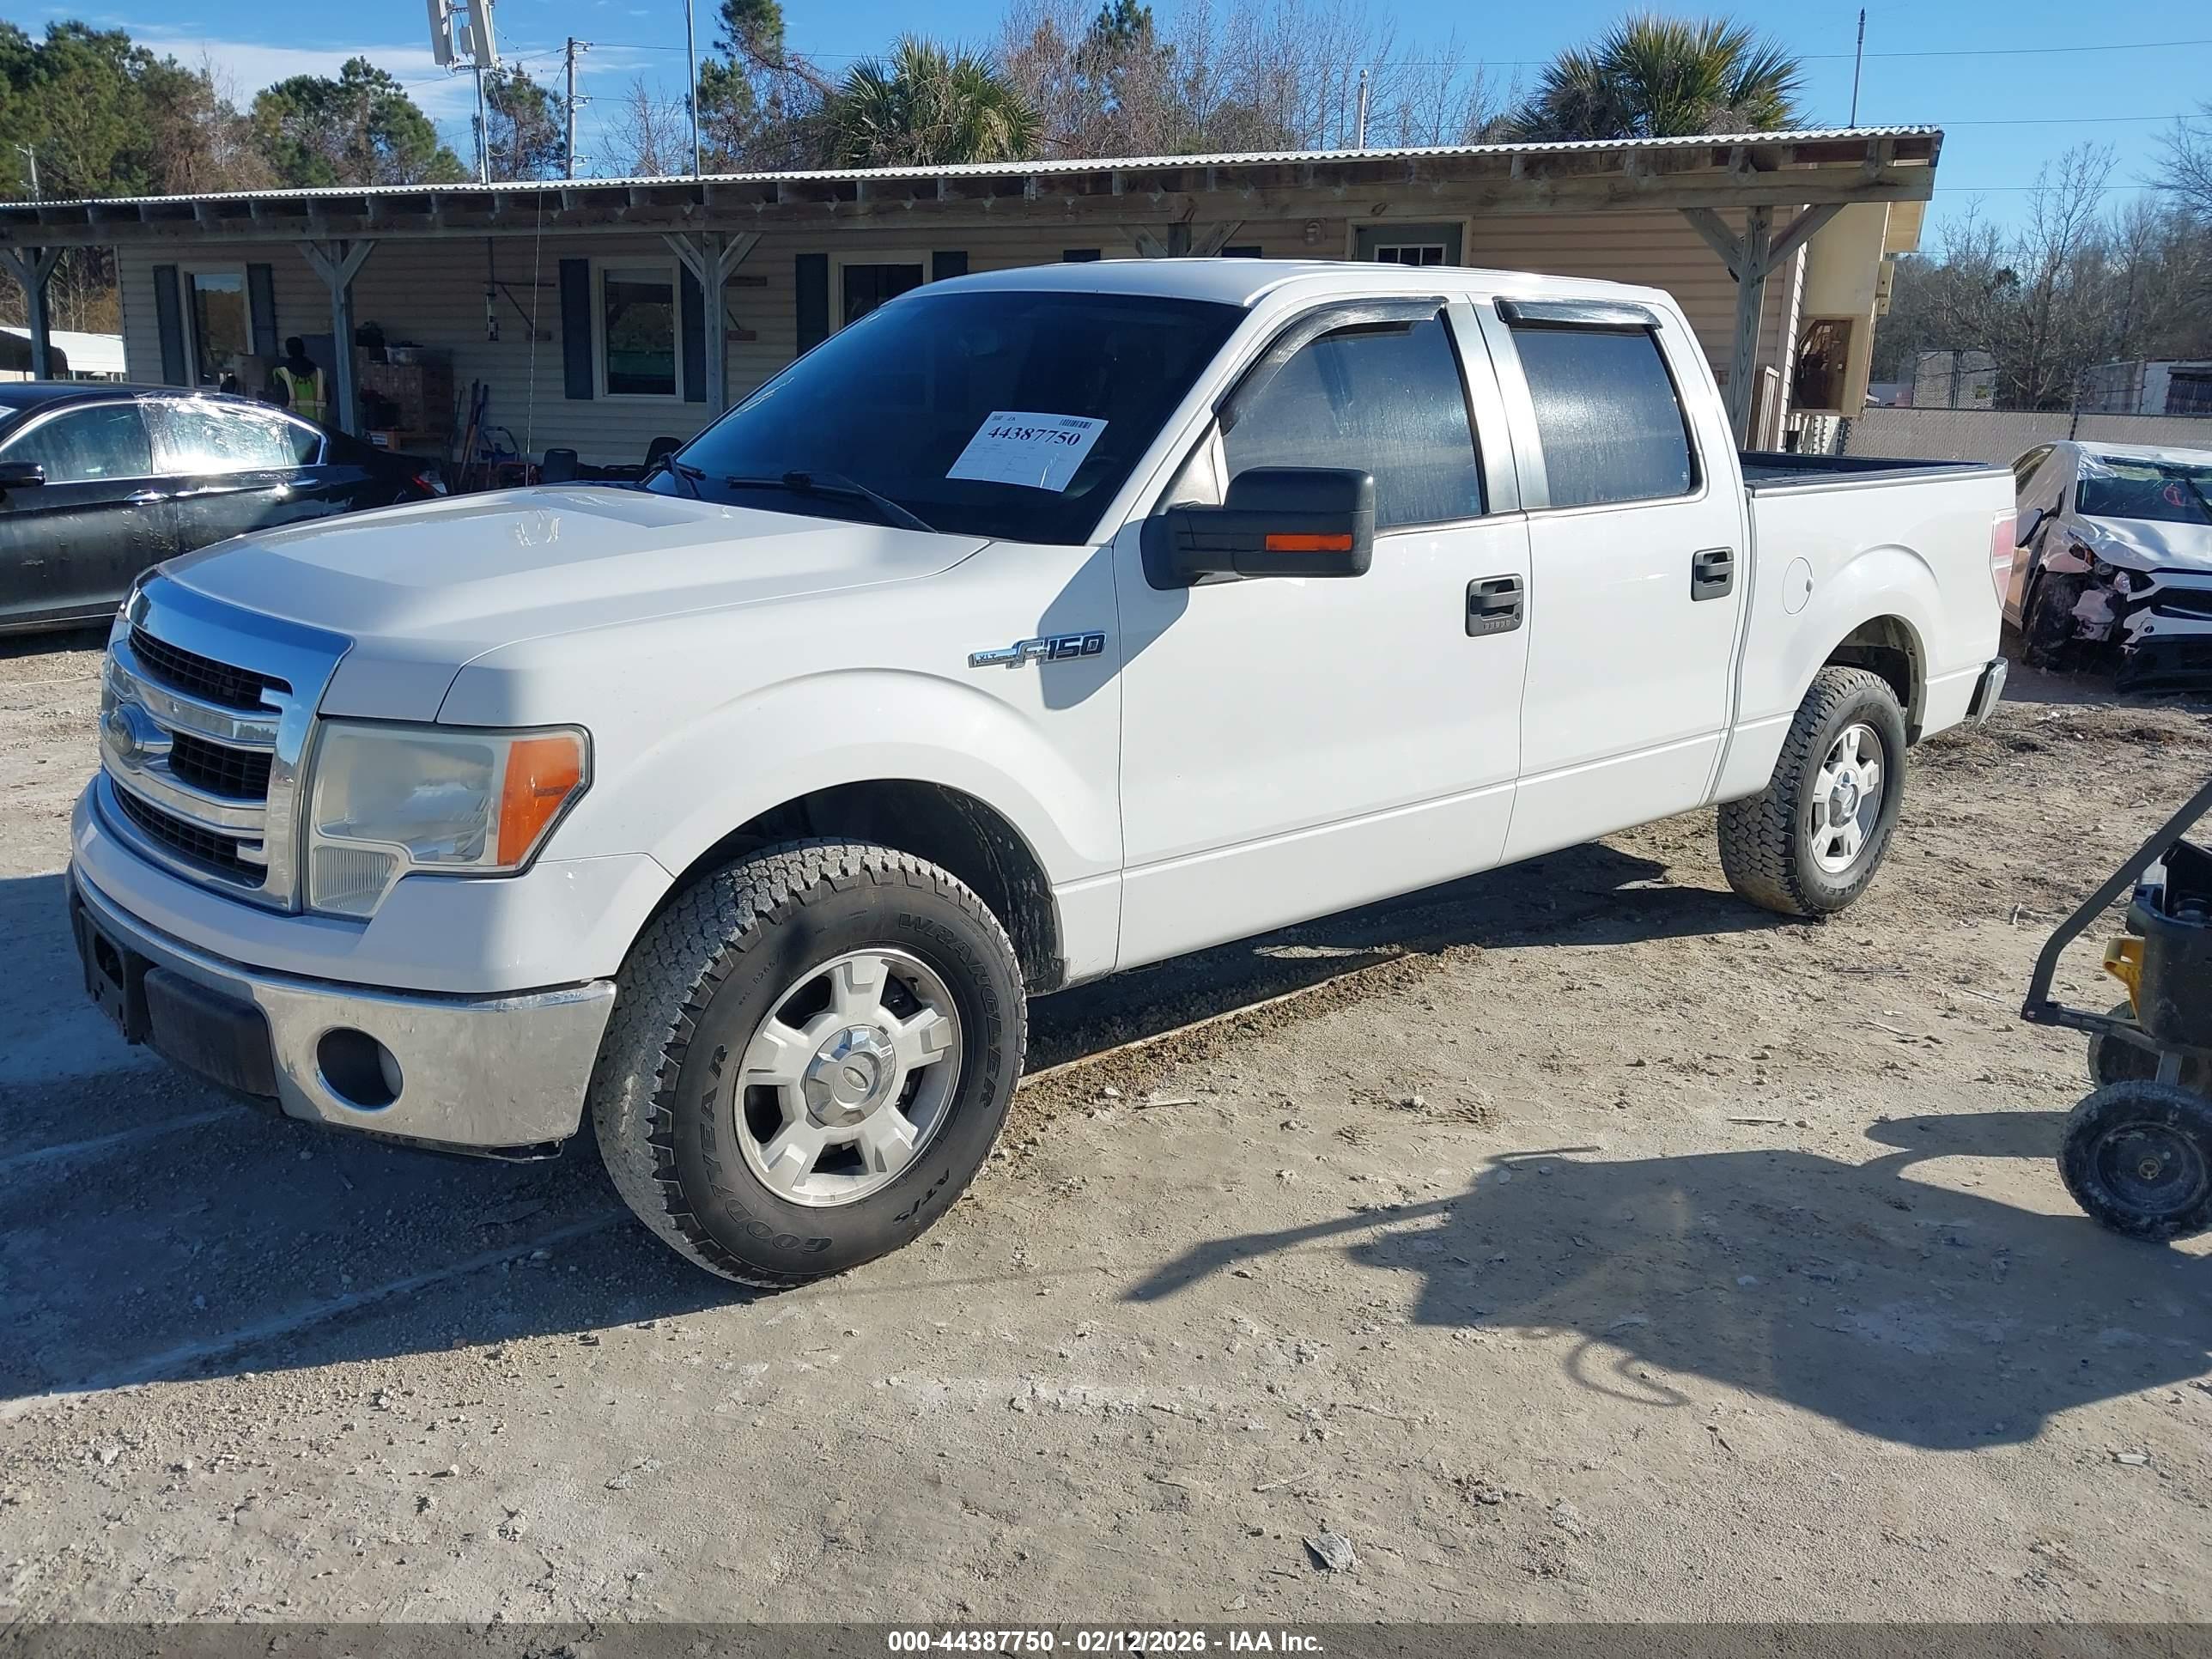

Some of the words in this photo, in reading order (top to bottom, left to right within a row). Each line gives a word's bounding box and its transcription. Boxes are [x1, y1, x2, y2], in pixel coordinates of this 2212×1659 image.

[988, 426, 1080, 446] 44387750
[899, 913, 1002, 1109] WRANGLER
[701, 1044, 832, 1254] GOODYEAR
